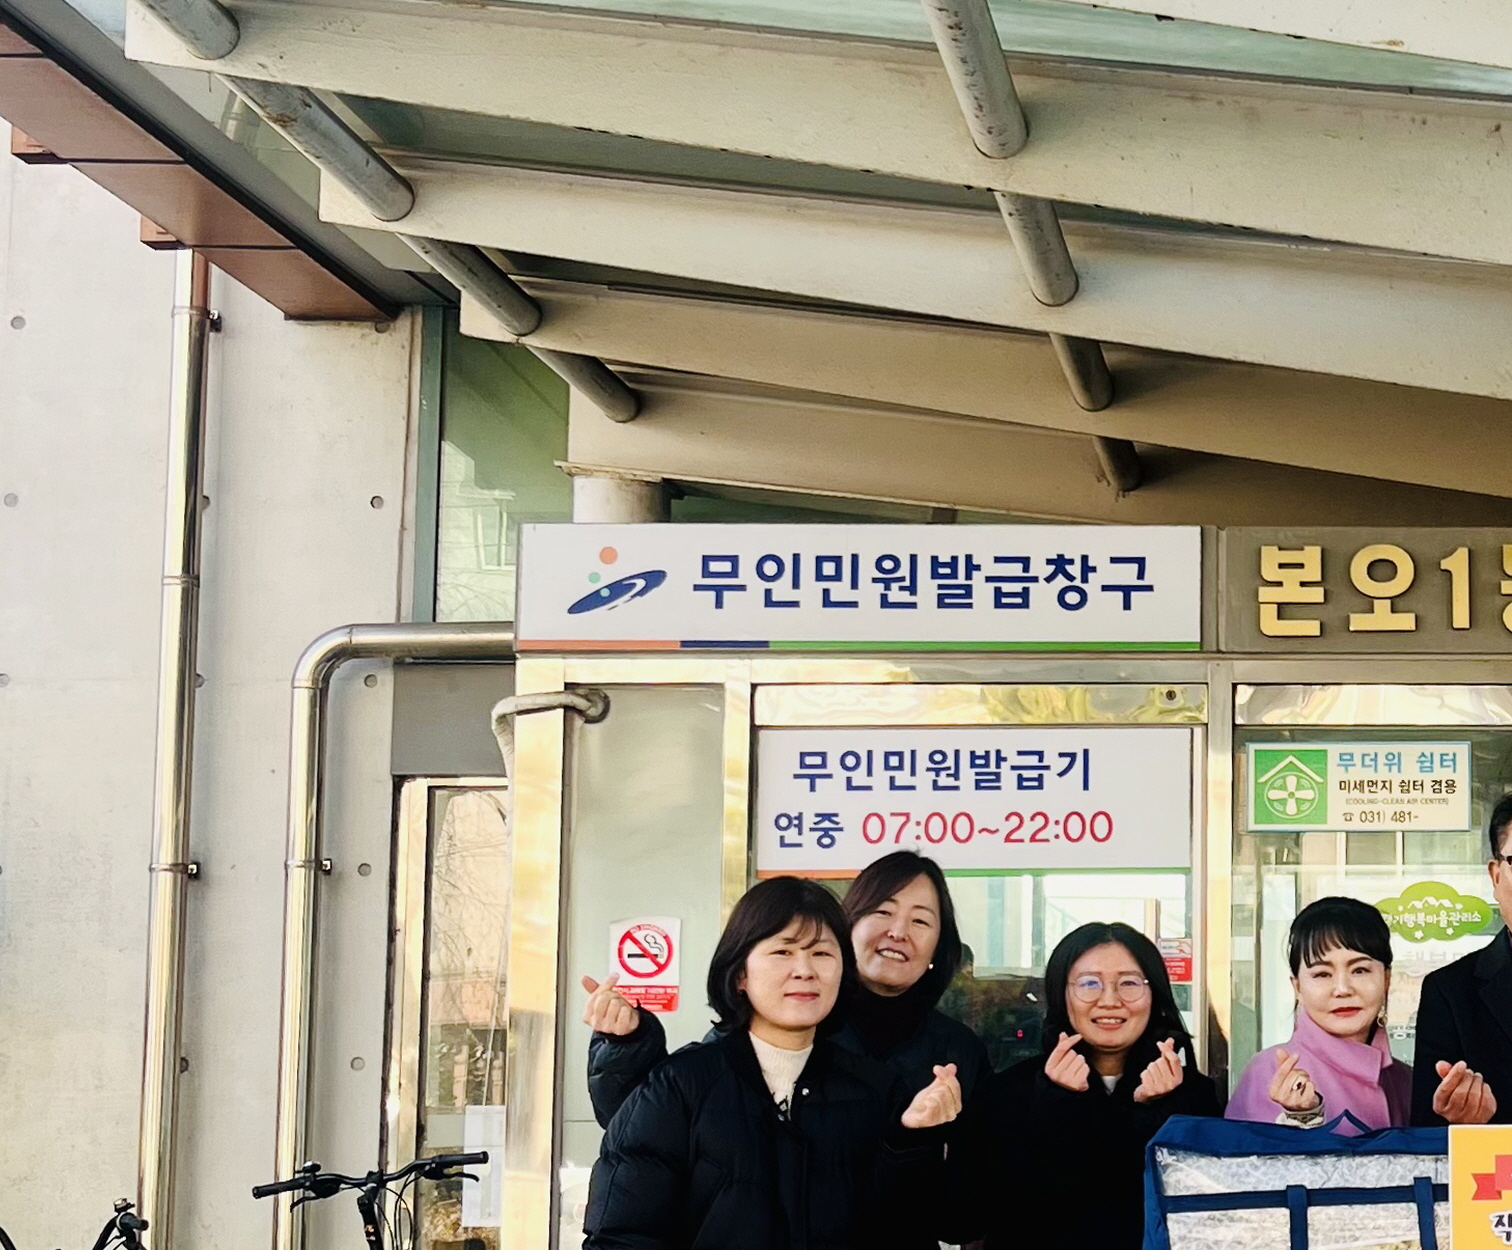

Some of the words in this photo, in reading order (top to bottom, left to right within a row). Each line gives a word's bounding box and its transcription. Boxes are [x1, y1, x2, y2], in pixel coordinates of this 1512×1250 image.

[693, 552, 1154, 612] 무인민원발급창구
[792, 748, 1092, 792] 무인민원발급기
[1337, 751, 1403, 774] 무더위
[1416, 751, 1458, 774] 쉼터
[1339, 779, 1393, 794] 미세먼지
[1398, 779, 1425, 794] 쉼터
[1430, 779, 1457, 795] 겸용
[773, 811, 844, 850] 연중
[861, 810, 1114, 846] 07:00~22:00
